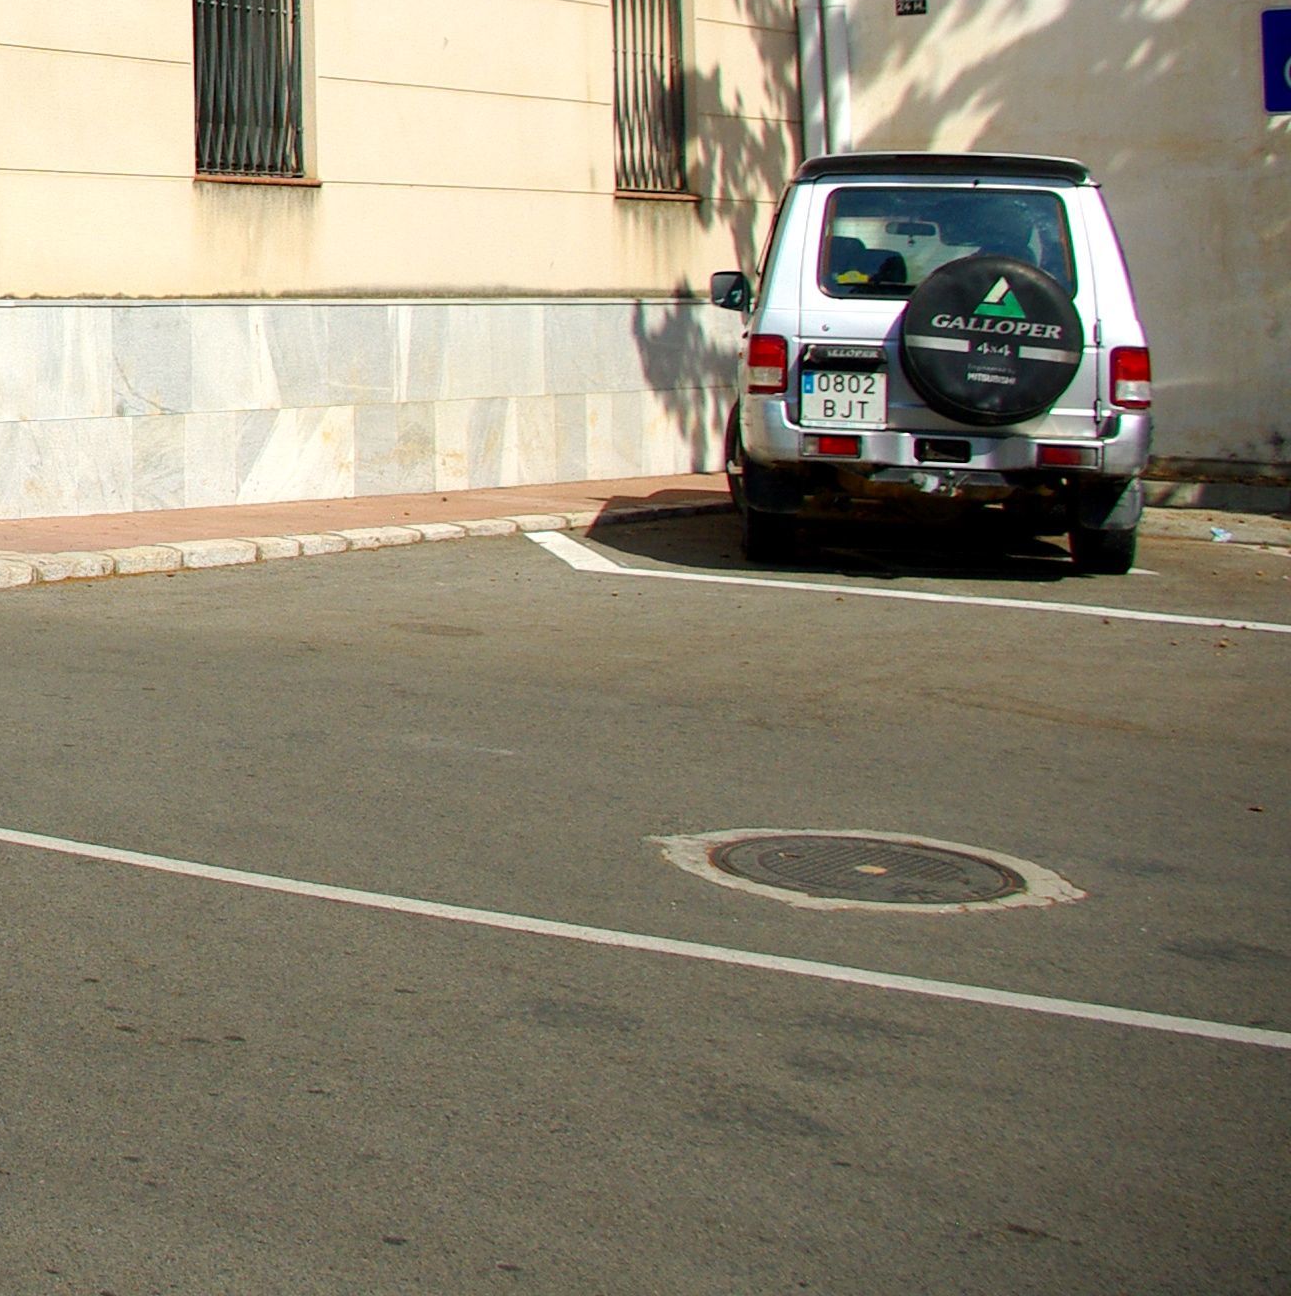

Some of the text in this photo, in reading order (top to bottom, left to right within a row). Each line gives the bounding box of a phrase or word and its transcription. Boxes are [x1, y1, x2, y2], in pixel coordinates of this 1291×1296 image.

[931, 314, 1062, 339] GALLOPER
[818, 373, 875, 394] 0802
[823, 399, 869, 419] BJT
